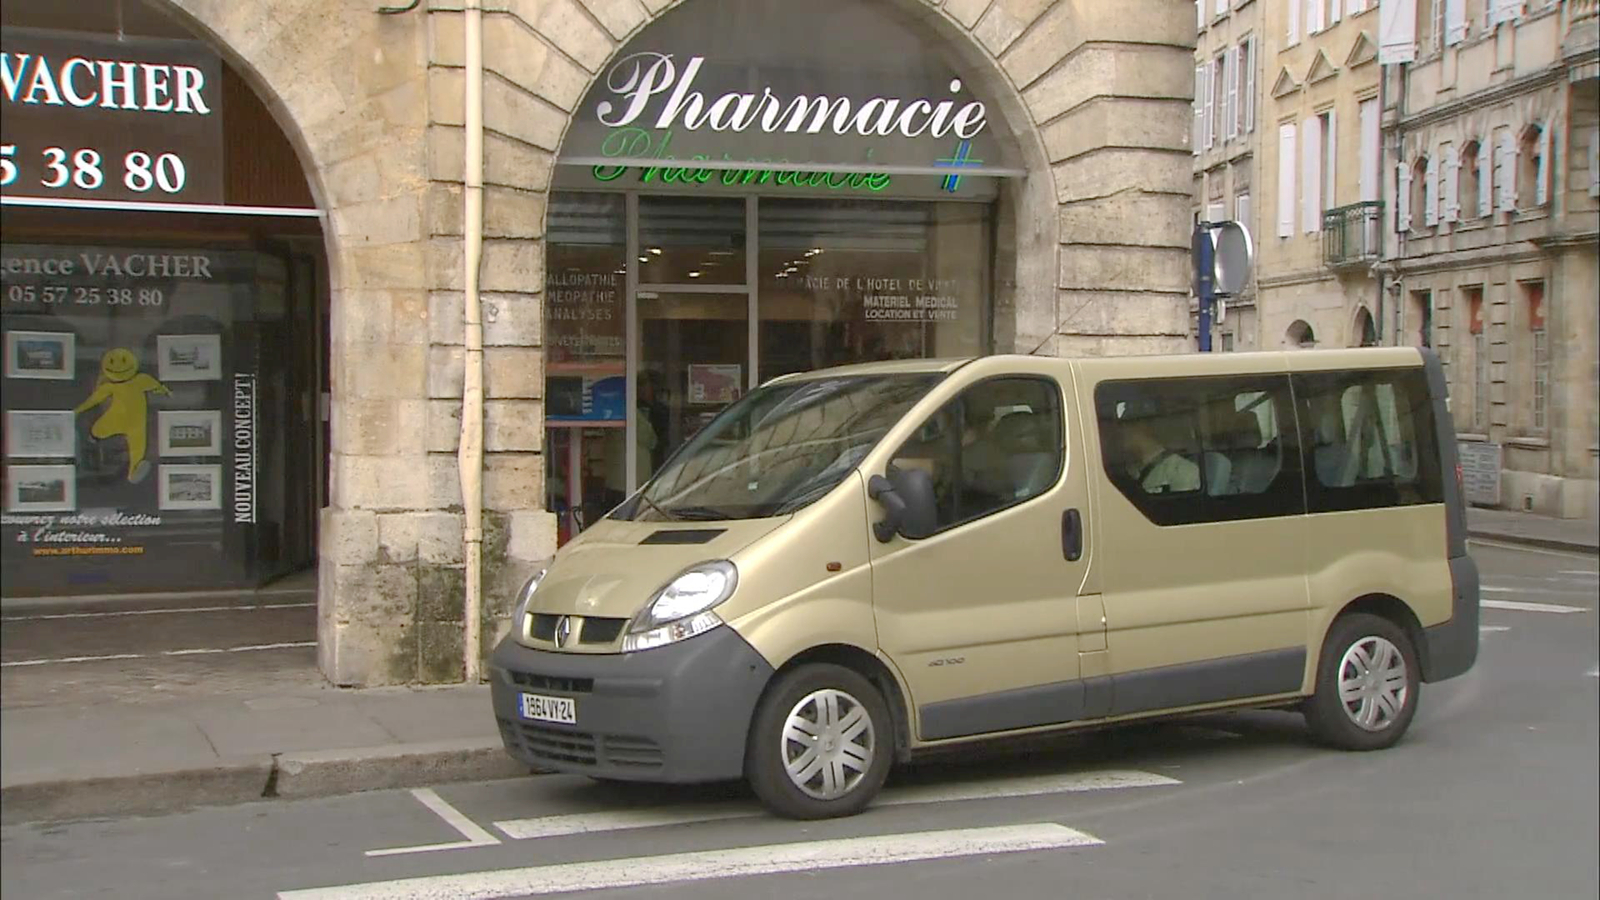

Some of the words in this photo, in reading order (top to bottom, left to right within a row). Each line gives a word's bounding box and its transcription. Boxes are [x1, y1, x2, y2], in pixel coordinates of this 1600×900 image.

[0, 52, 211, 115] VACHER
[596, 52, 988, 139] Pharmacie
[0, 145, 18, 187] 5
[40, 147, 104, 190] 38
[123, 151, 187, 194] 80
[593, 127, 891, 191] Pharmacie
[79, 253, 214, 279] VACHER
[547, 273, 617, 287] ALLOPATHIE
[836, 278, 850, 291] DE
[857, 278, 902, 291] L'HOTEL
[909, 279, 923, 291] DE
[8, 285, 36, 302] 05
[42, 286, 69, 303] 57
[74, 287, 101, 304] 25
[106, 288, 132, 305] 38
[138, 289, 164, 306] 80
[864, 295, 911, 308] MATERIEL
[916, 296, 958, 308] MEDICAL
[865, 309, 911, 319] LOCATION
[913, 310, 925, 319] ET
[928, 310, 958, 320] VENTE
[234, 452, 252, 523] NOUVEAU
[59, 513, 97, 526] notre
